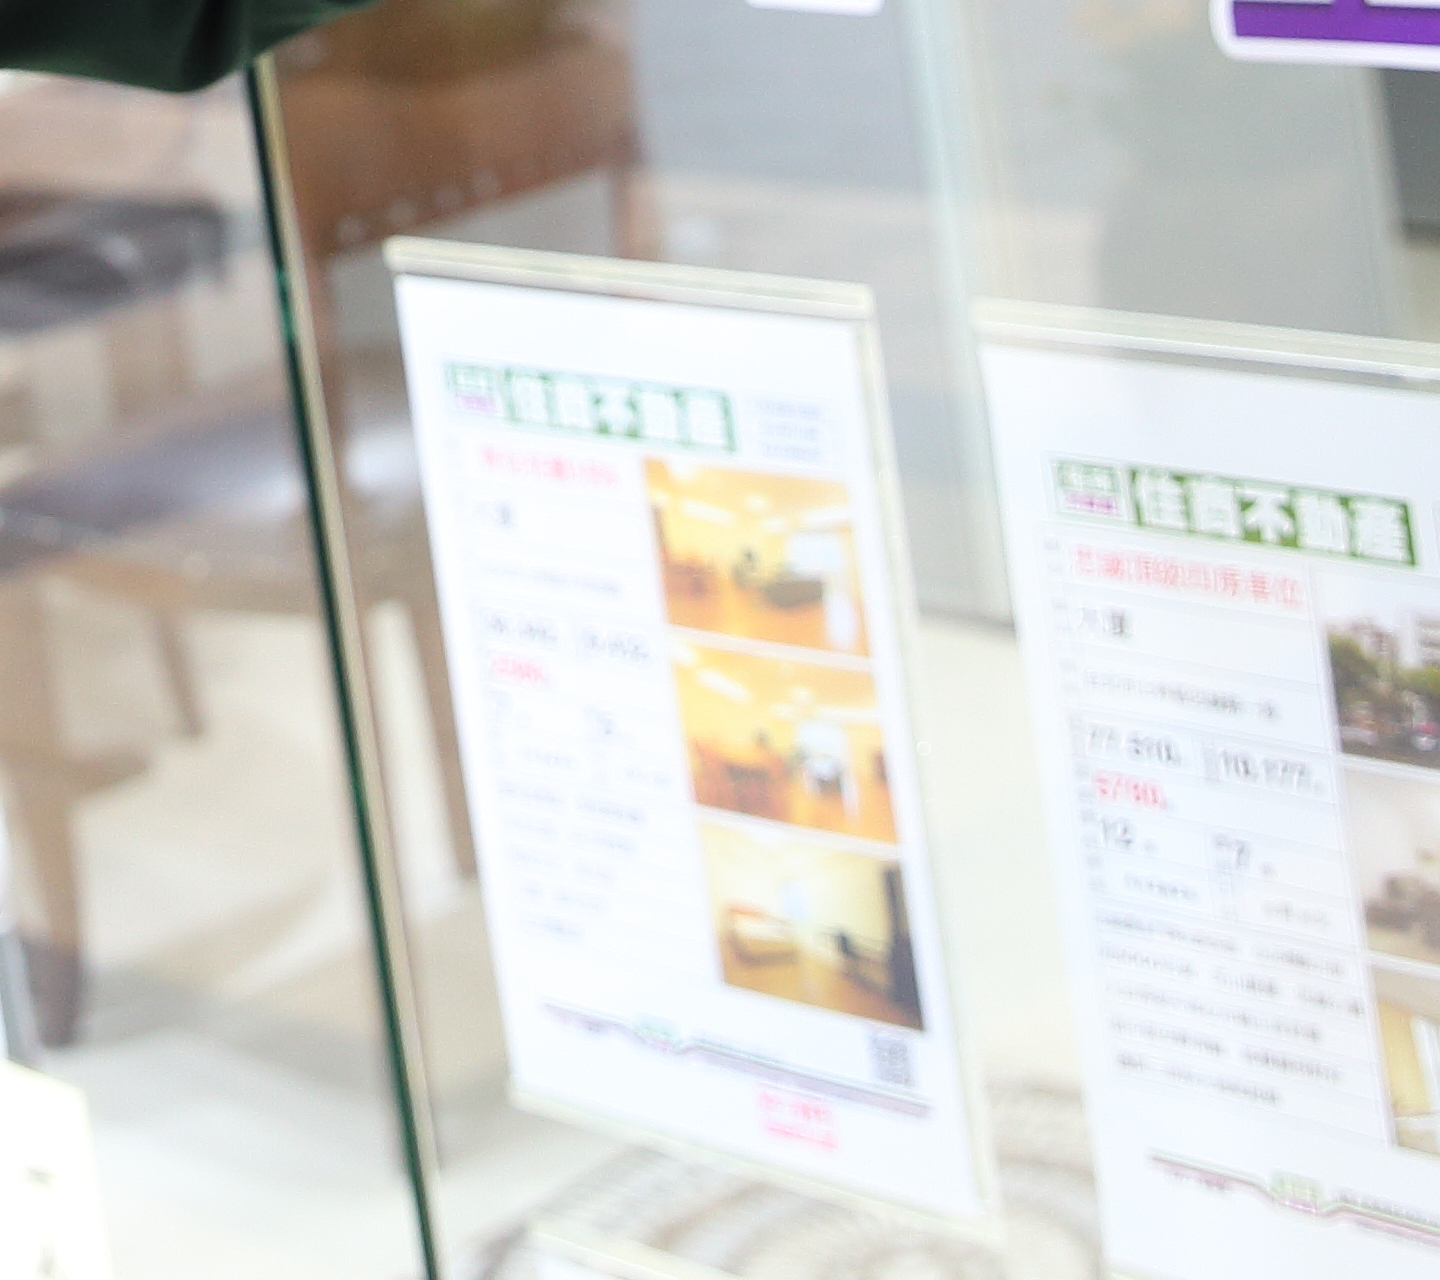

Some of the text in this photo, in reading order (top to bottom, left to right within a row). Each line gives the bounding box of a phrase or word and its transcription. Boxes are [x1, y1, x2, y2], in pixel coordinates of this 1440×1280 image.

[1135, 466, 1410, 566] 住商不動產
